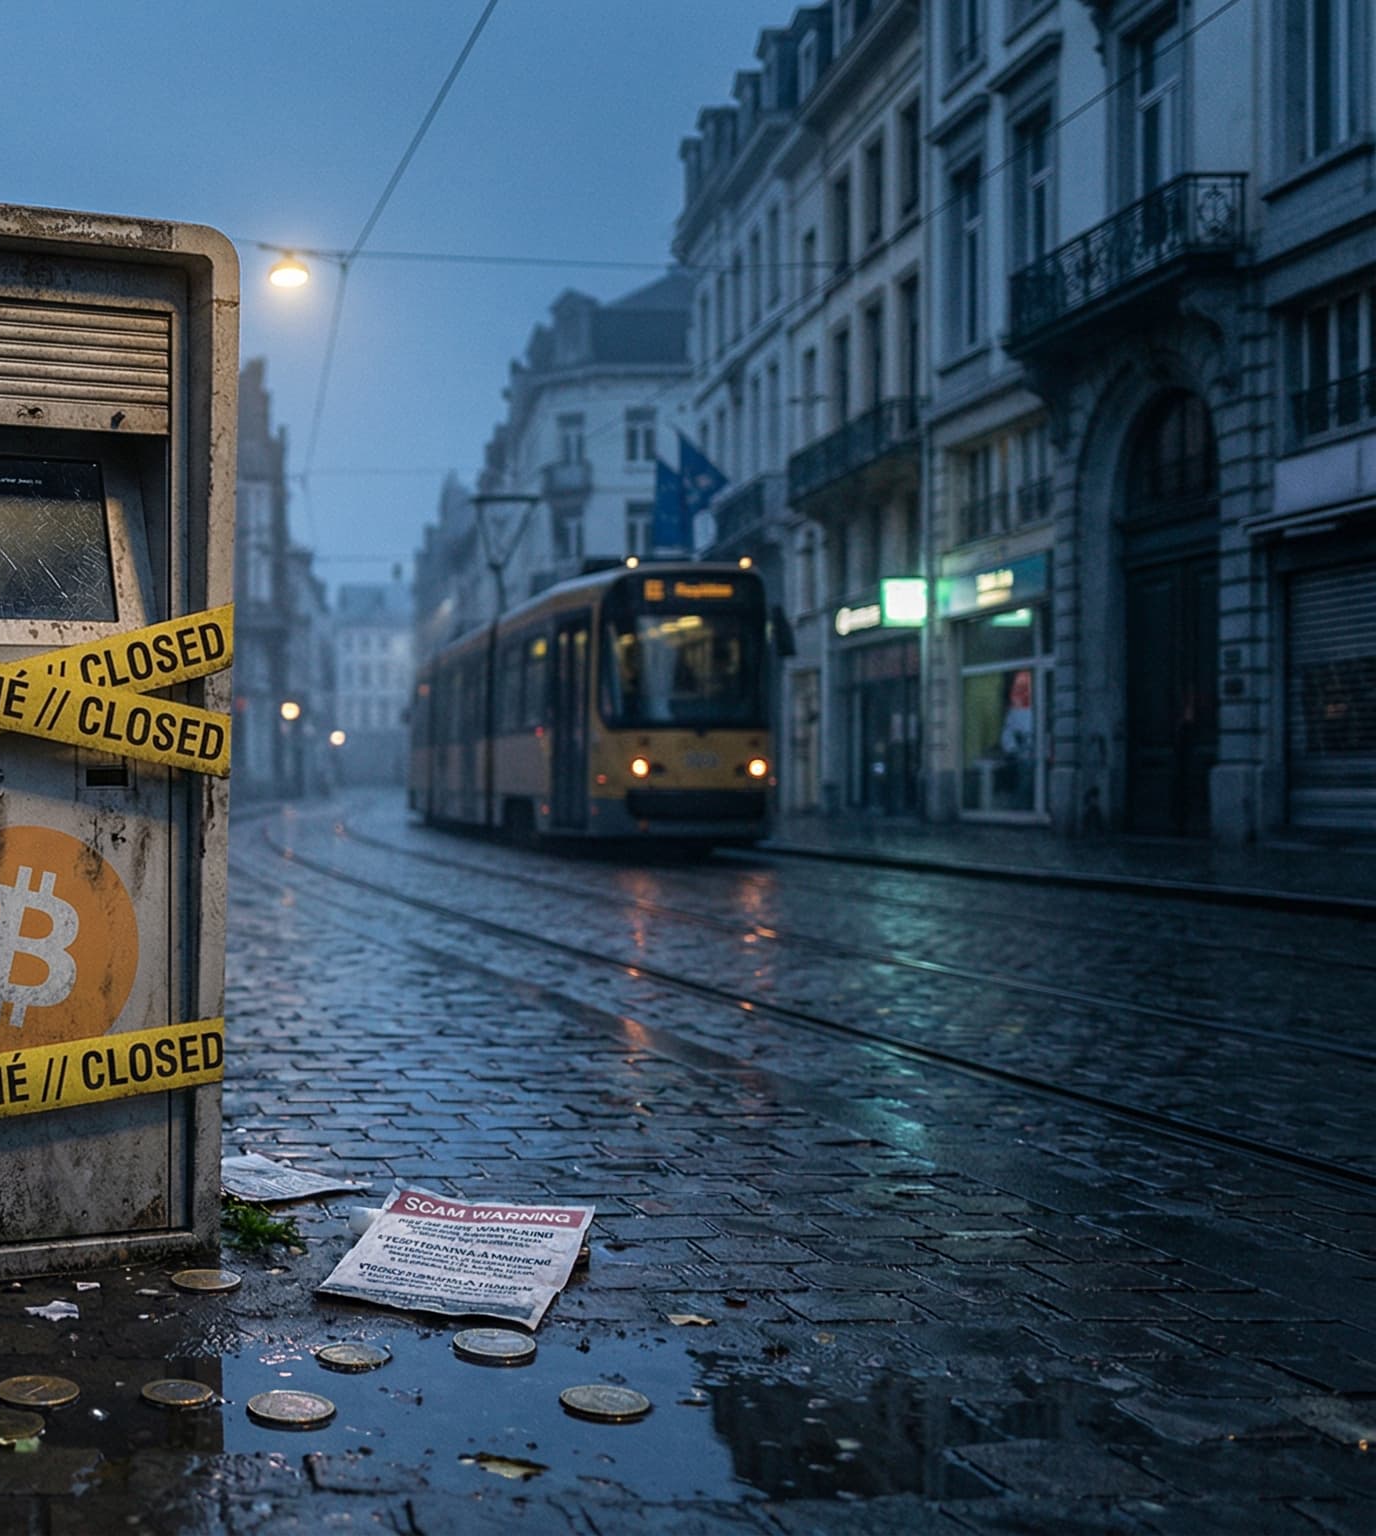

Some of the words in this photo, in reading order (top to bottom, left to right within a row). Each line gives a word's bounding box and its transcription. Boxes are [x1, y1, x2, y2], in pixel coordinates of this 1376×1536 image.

[80, 622, 225, 687] CLOSED
[78, 696, 224, 760] CLOSED
[82, 1032, 224, 1090] CLOSED
[404, 1197, 466, 1218] SCAM
